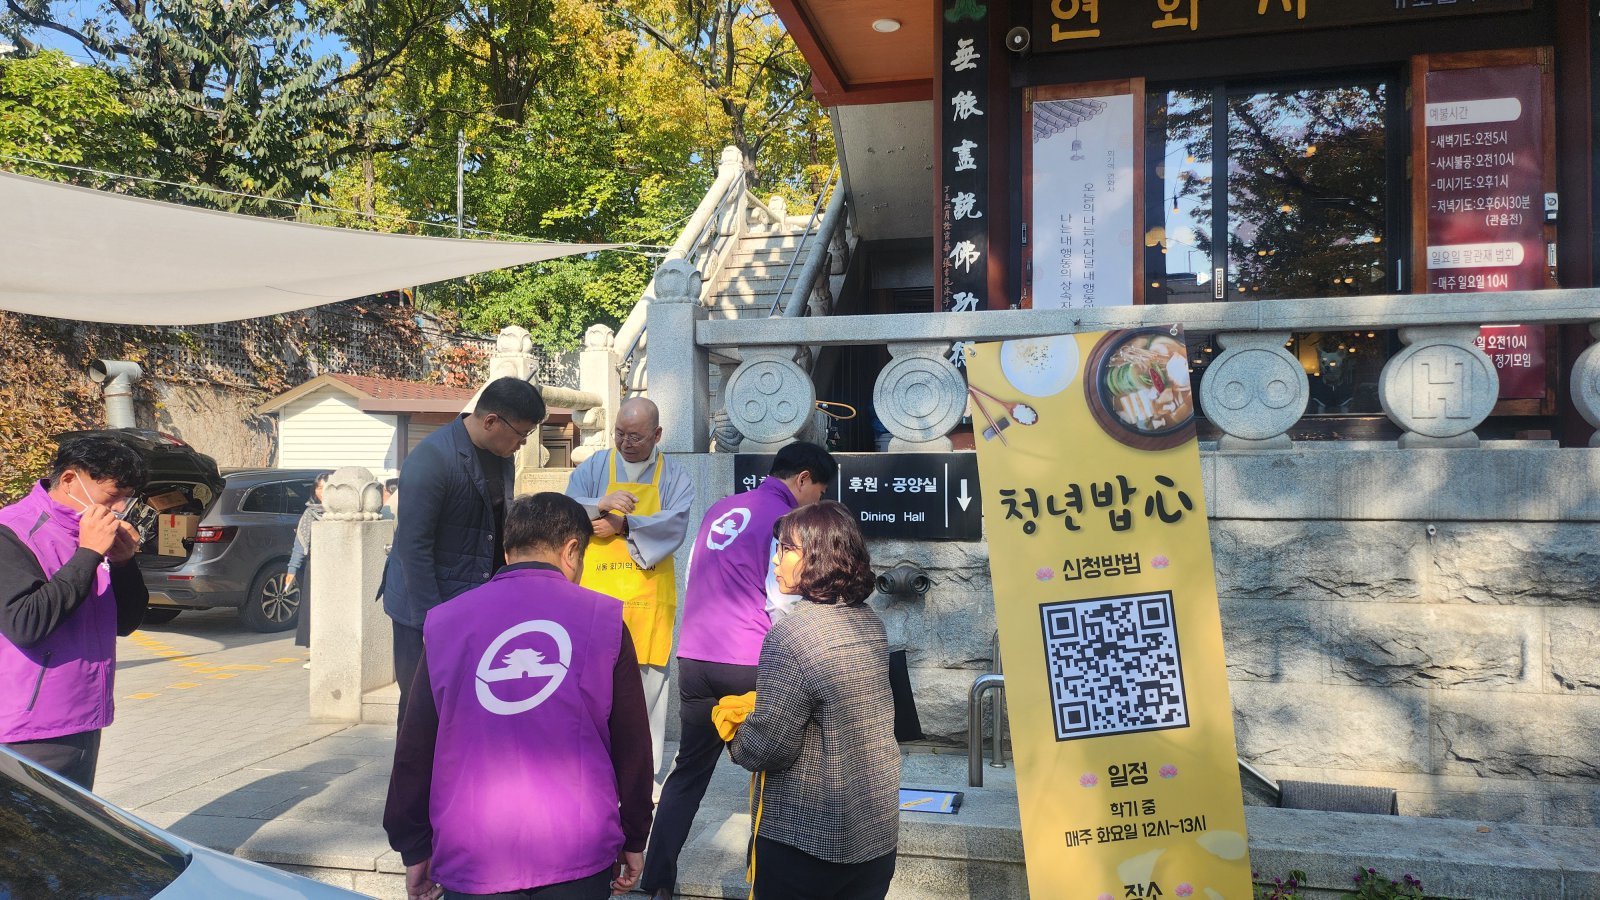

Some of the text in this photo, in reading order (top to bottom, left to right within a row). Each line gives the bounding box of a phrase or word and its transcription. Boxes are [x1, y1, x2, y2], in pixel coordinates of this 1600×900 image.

[1430, 106, 1468, 121] 예불시간
[1431, 131, 1508, 148] -새벽기도:오전5시
[1431, 174, 1509, 191] -미시기도:오후1시
[1082, 183, 1095, 214] 오늘의
[1060, 213, 1072, 234] 나는
[1082, 216, 1096, 236] 나는
[1485, 213, 1523, 227] (관음전)
[1060, 248, 1072, 278] 행동의
[1432, 247, 1514, 265] 일요일 팔관재 법회
[1458, 275, 1485, 289] 일요일
[1487, 273, 1508, 288] 10시
[1488, 335, 1527, 349] 오전10시
[1495, 353, 1531, 368] 정기모임
[848, 477, 878, 493] 후원
[892, 477, 937, 493] 공양실
[999, 475, 1193, 535] 청년밥心
[860, 511, 925, 523] Dining Hall
[596, 563, 608, 571] 서울
[610, 562, 632, 570] 회기역
[1063, 552, 1141, 581] 신청방법
[1108, 762, 1149, 788] 일정
[1110, 799, 1156, 818] 학기 중
[1065, 815, 1207, 847] 매주 화요일 12시~13시
